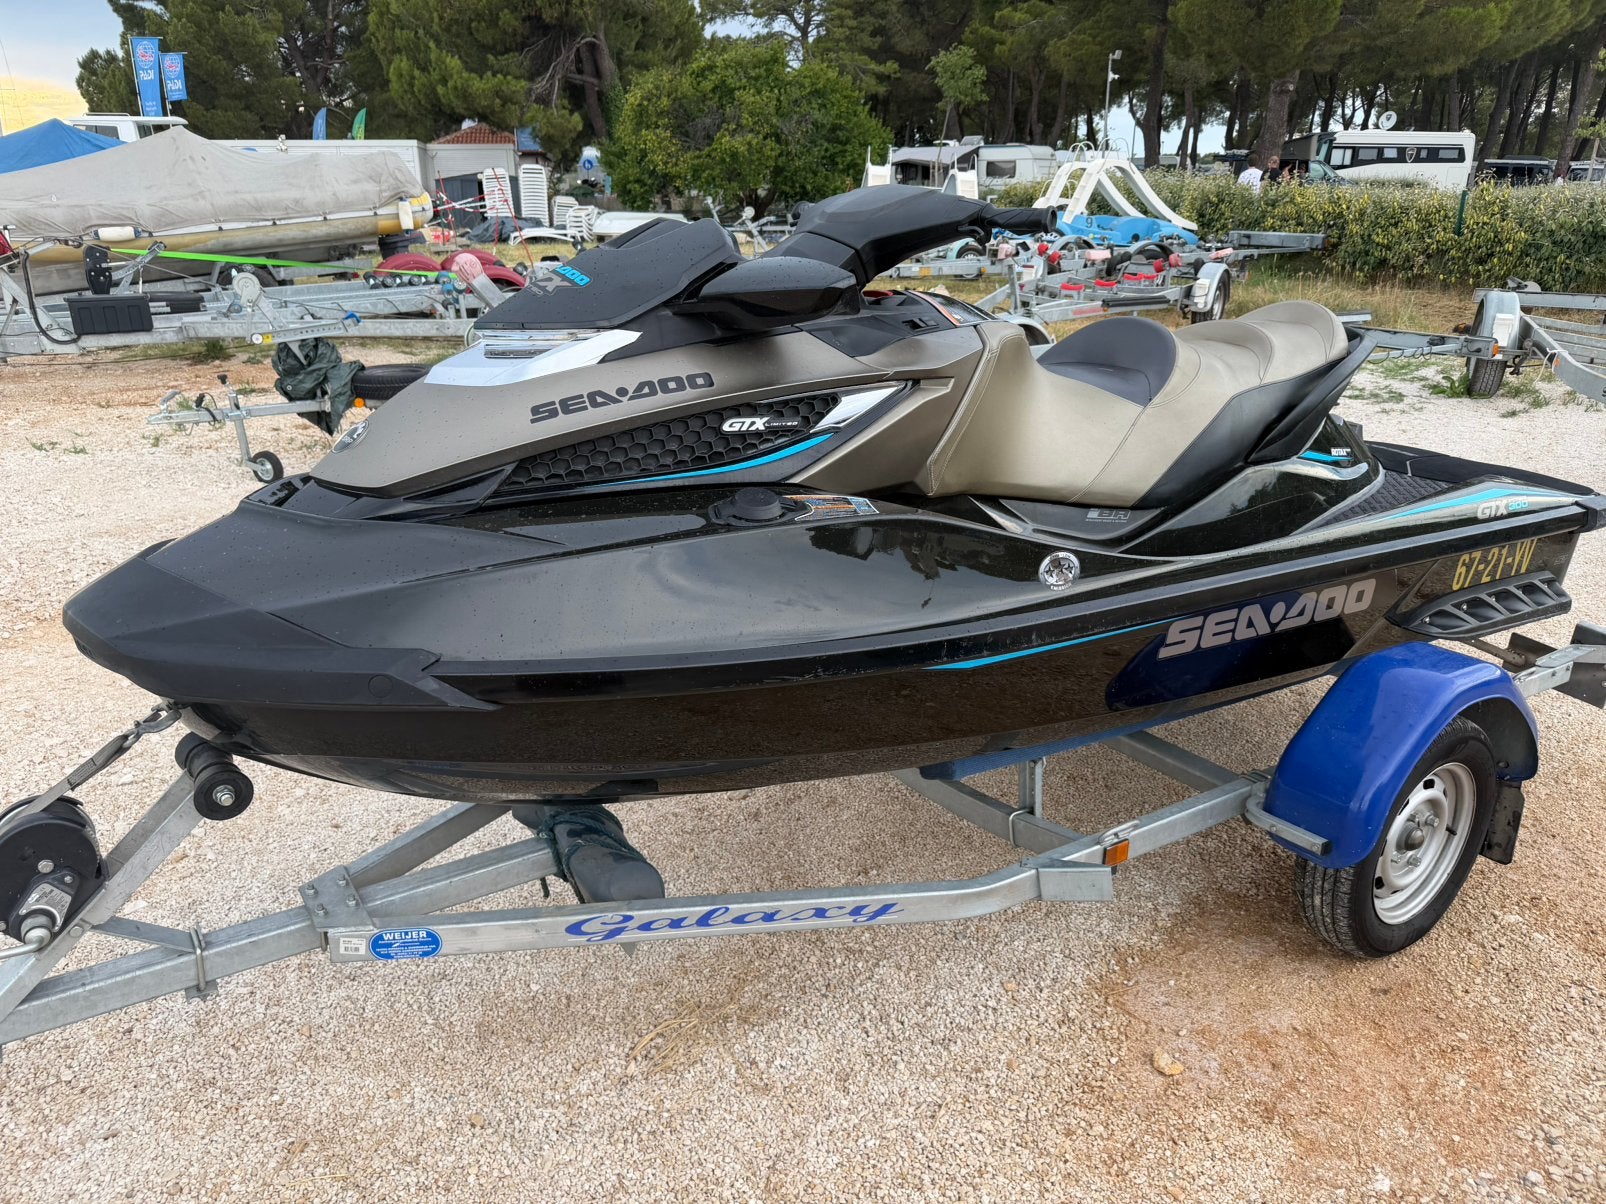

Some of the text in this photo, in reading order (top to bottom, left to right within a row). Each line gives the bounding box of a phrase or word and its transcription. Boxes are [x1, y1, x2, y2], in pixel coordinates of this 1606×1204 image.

[1085, 217, 1094, 228] 9
[722, 417, 771, 432] GTX
[1477, 500, 1529, 519] GTX 300
[1452, 538, 1538, 591] 67-21-YV
[564, 902, 904, 942] Galaxy
[383, 931, 427, 940] WEIJER
